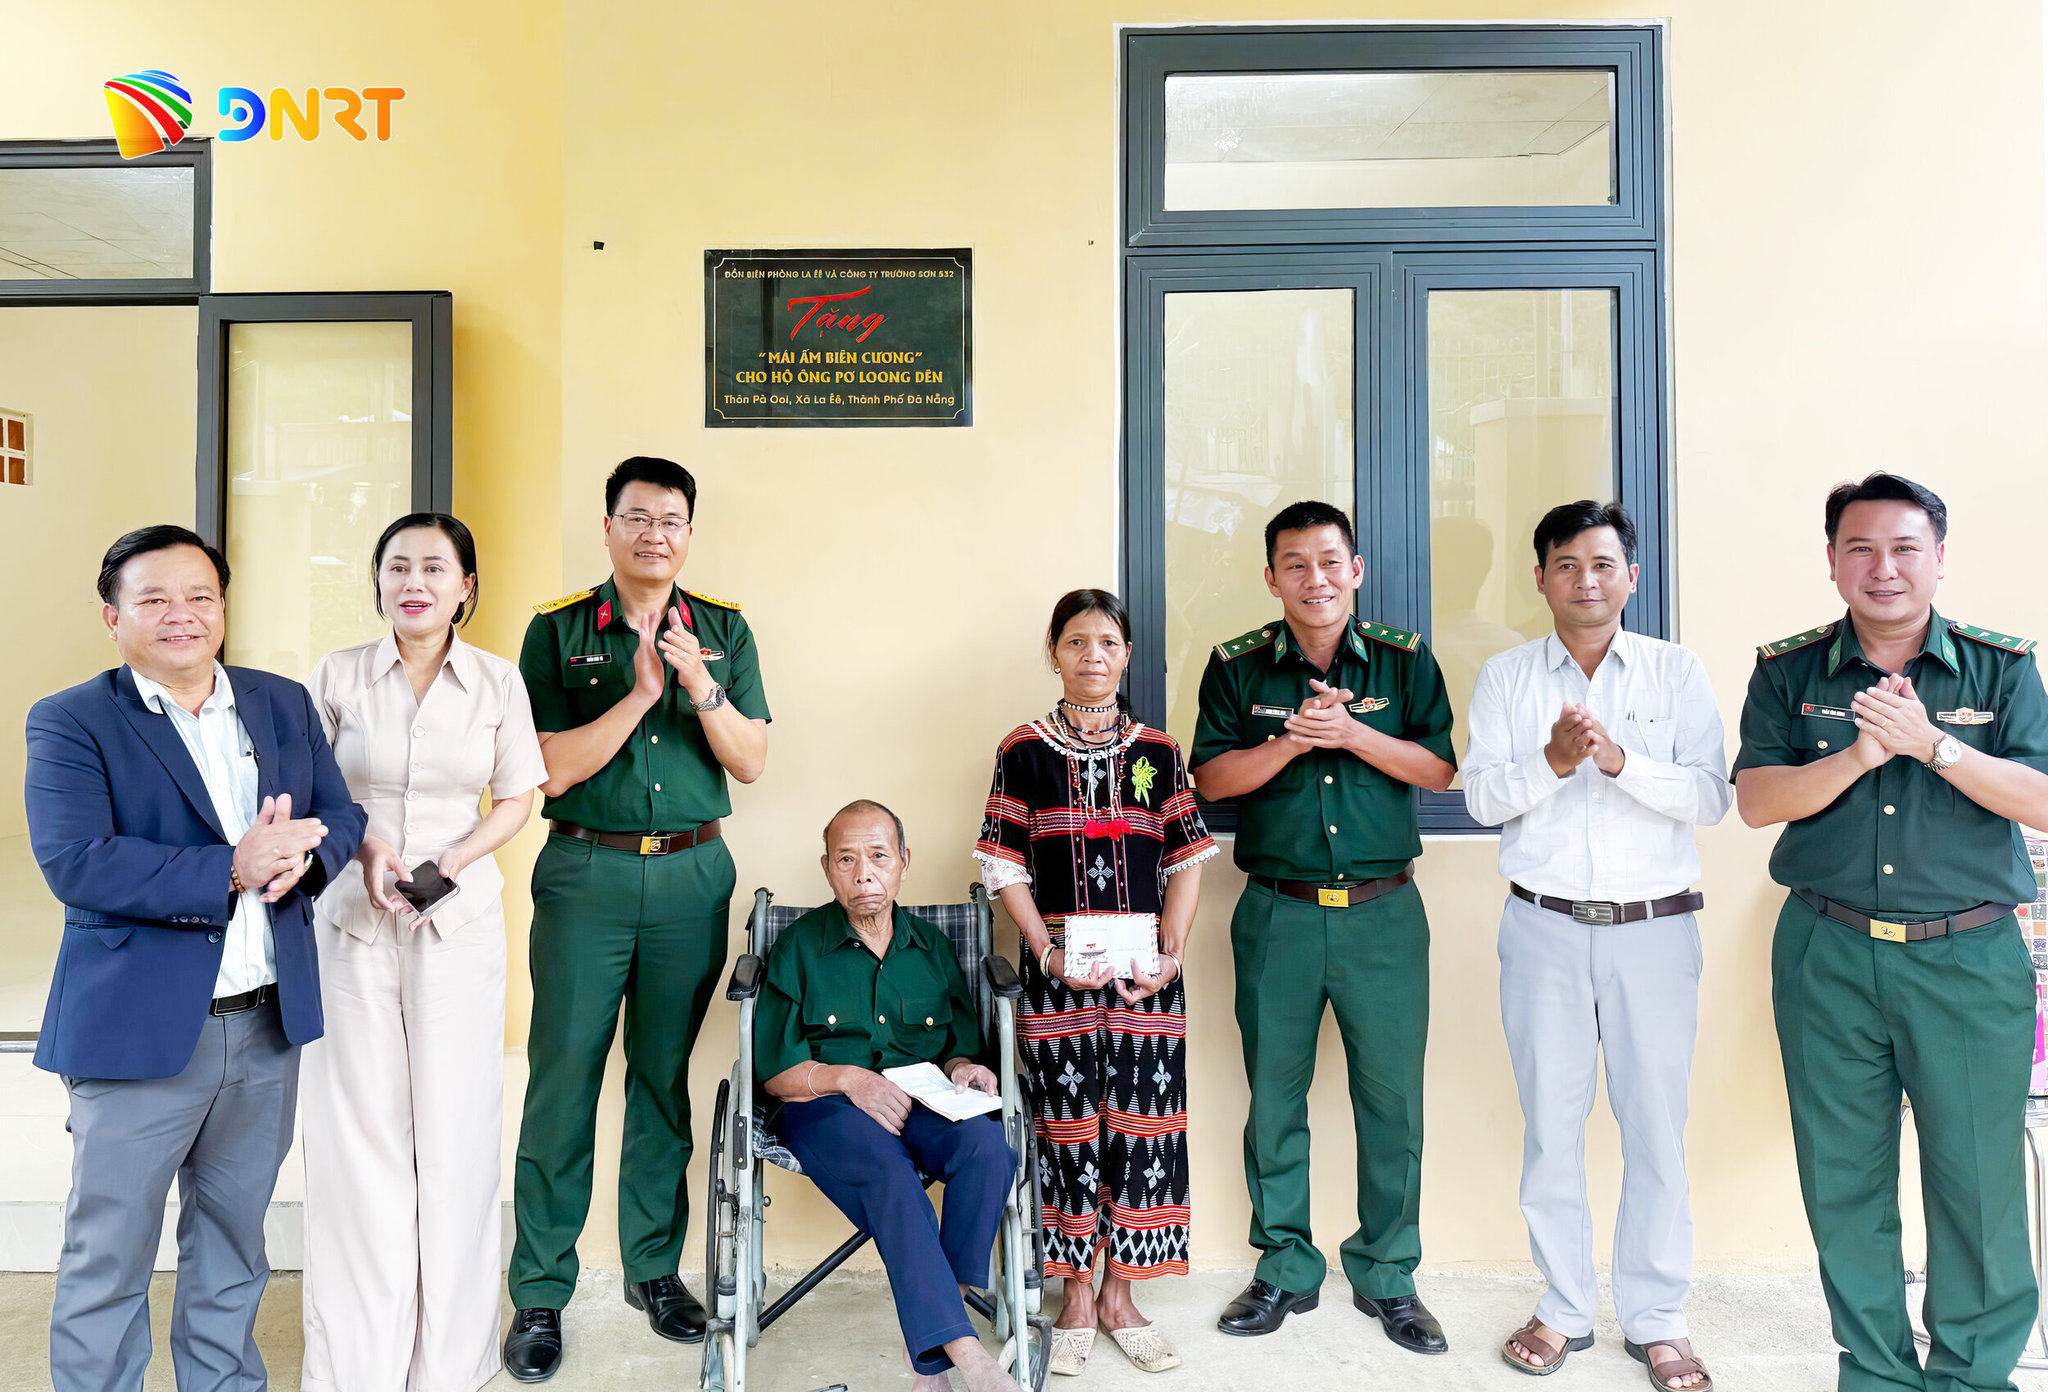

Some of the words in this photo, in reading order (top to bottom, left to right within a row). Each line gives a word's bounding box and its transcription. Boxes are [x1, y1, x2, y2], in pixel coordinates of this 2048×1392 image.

[767, 269, 799, 279] PHÒNG
[801, 270, 811, 279] LA
[839, 269, 867, 279] CÔNG
[868, 270, 879, 279] TY
[787, 285, 889, 344] Tặng
[799, 348, 822, 364] ẤM
[826, 350, 858, 364] BIÊN
[735, 370, 768, 384] CHO
[771, 369, 794, 386] HỘ
[797, 369, 831, 384] ÔNG
[835, 370, 856, 384] PƠ
[859, 370, 911, 384] LOONG
[915, 369, 943, 384] DÊN
[724, 394, 750, 404] Thôn
[813, 394, 826, 404] La
[847, 394, 881, 404] Thành
[883, 393, 905, 404] Phố
[907, 394, 923, 404] Đà
[925, 393, 955, 406] Nẵng
